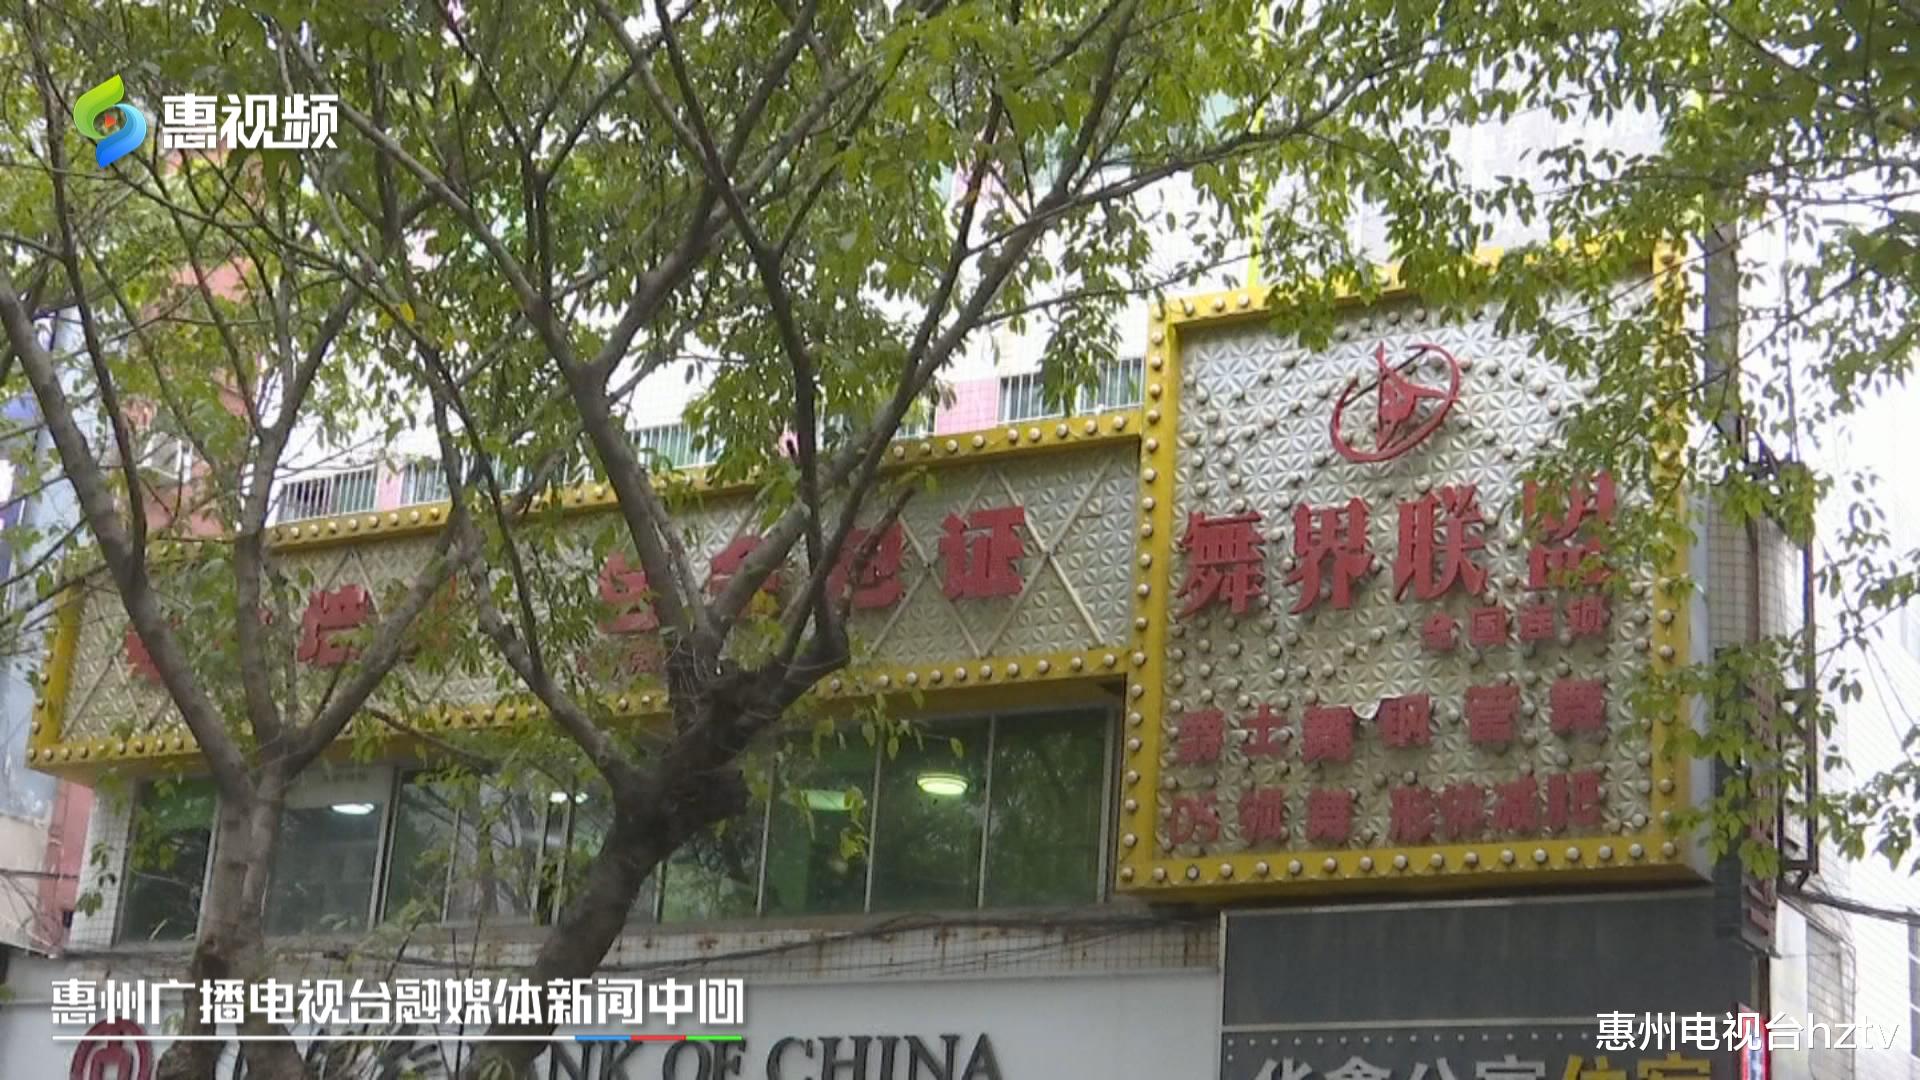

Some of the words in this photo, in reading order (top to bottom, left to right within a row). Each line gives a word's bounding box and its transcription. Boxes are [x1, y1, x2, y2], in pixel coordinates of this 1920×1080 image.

[1176, 470, 1616, 615] 舞界联盟
[766, 1032, 1004, 1080] CHINA
